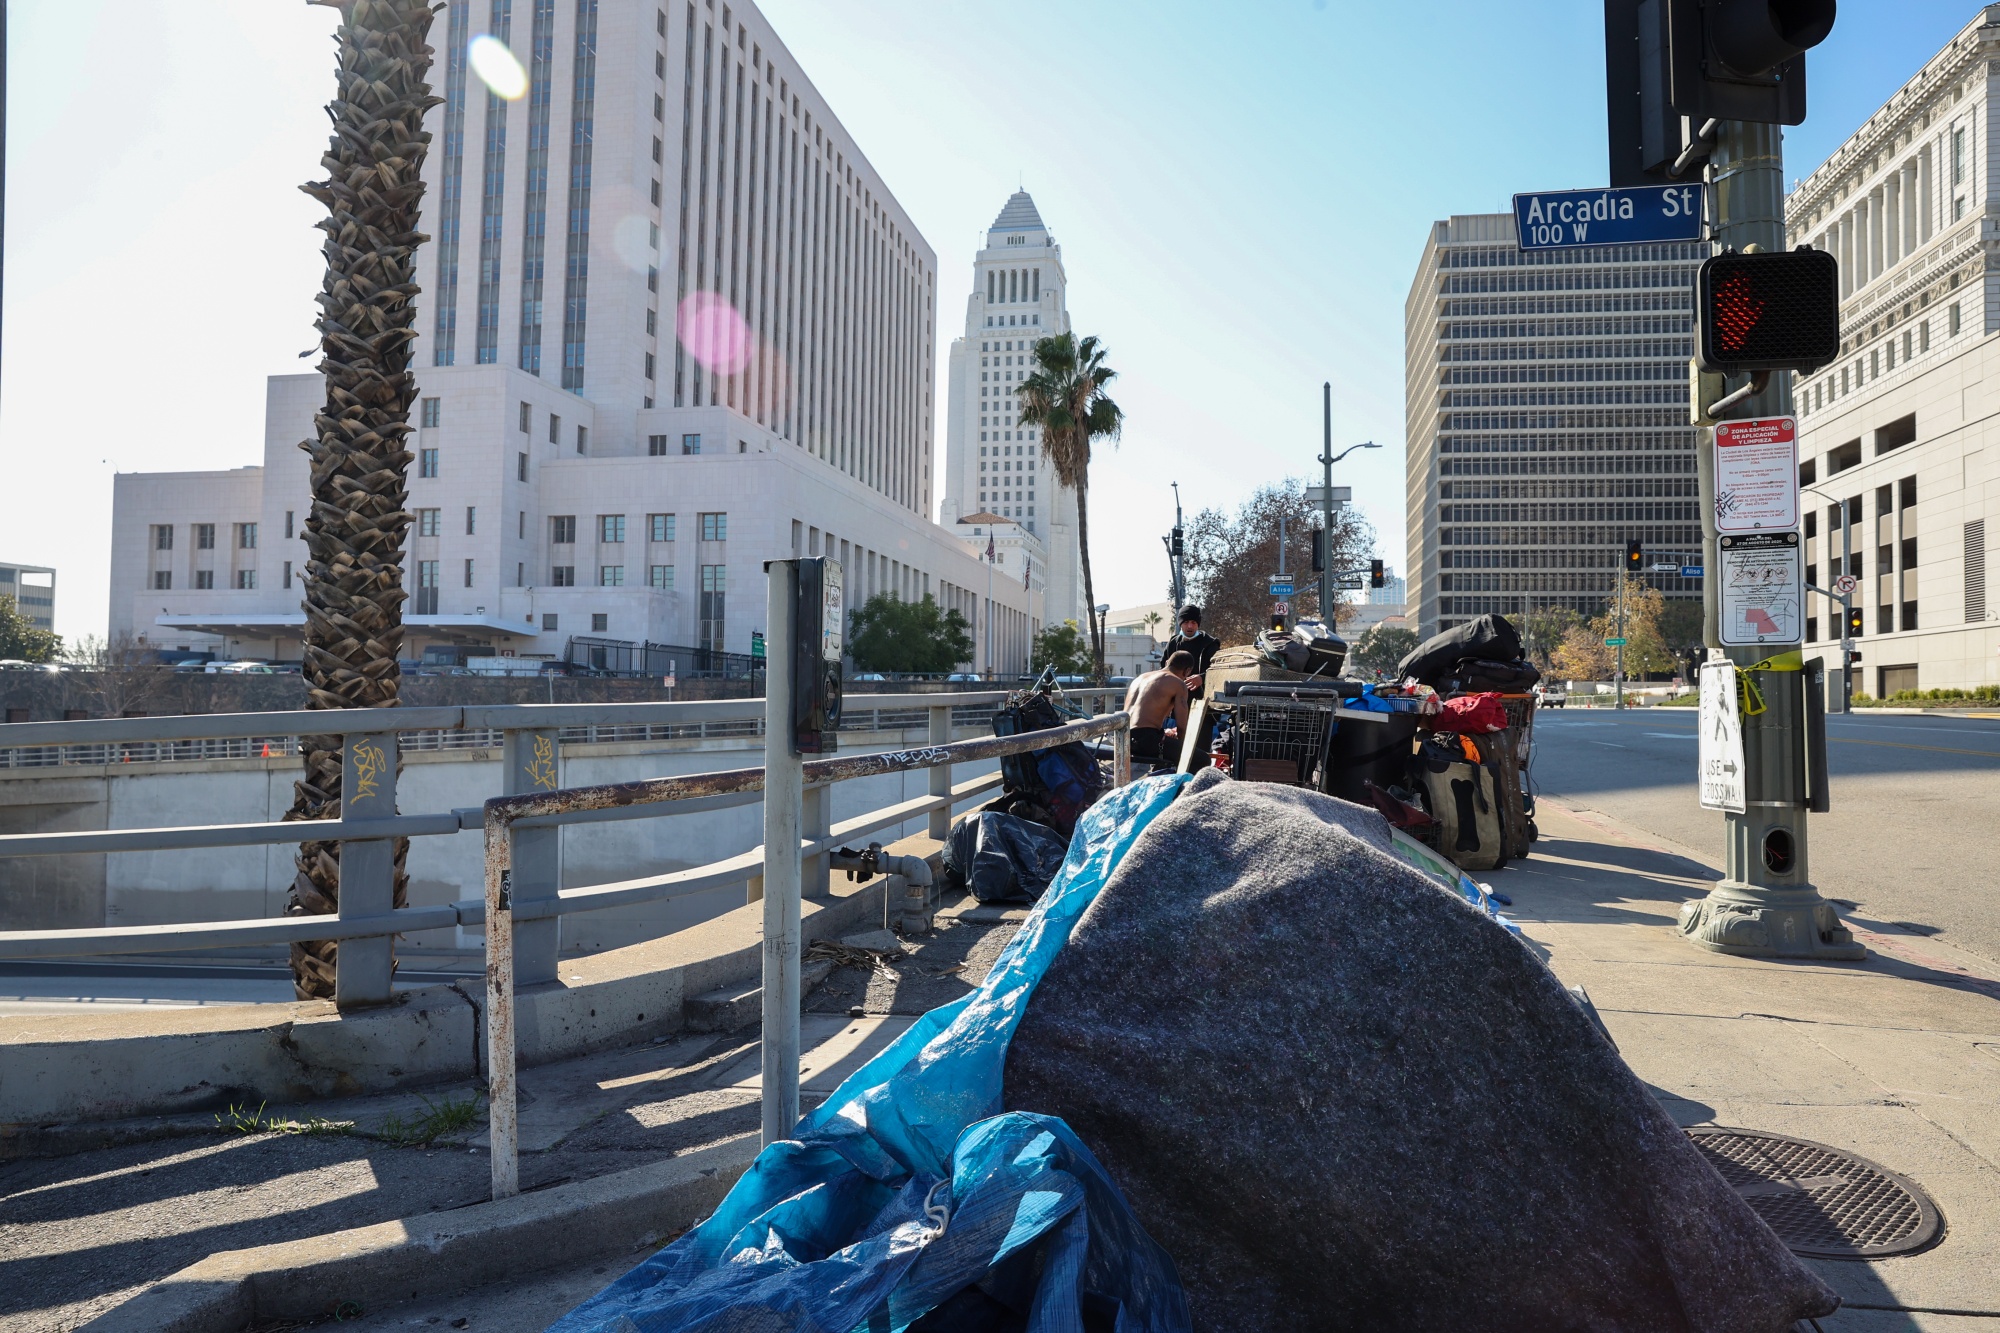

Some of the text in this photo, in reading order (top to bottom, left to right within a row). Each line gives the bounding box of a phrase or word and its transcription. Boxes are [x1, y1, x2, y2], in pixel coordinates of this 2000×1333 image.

[1527, 187, 1692, 225] Arcadia St
[1531, 223, 1588, 245] 100 W
[1706, 760, 1722, 776] USE
